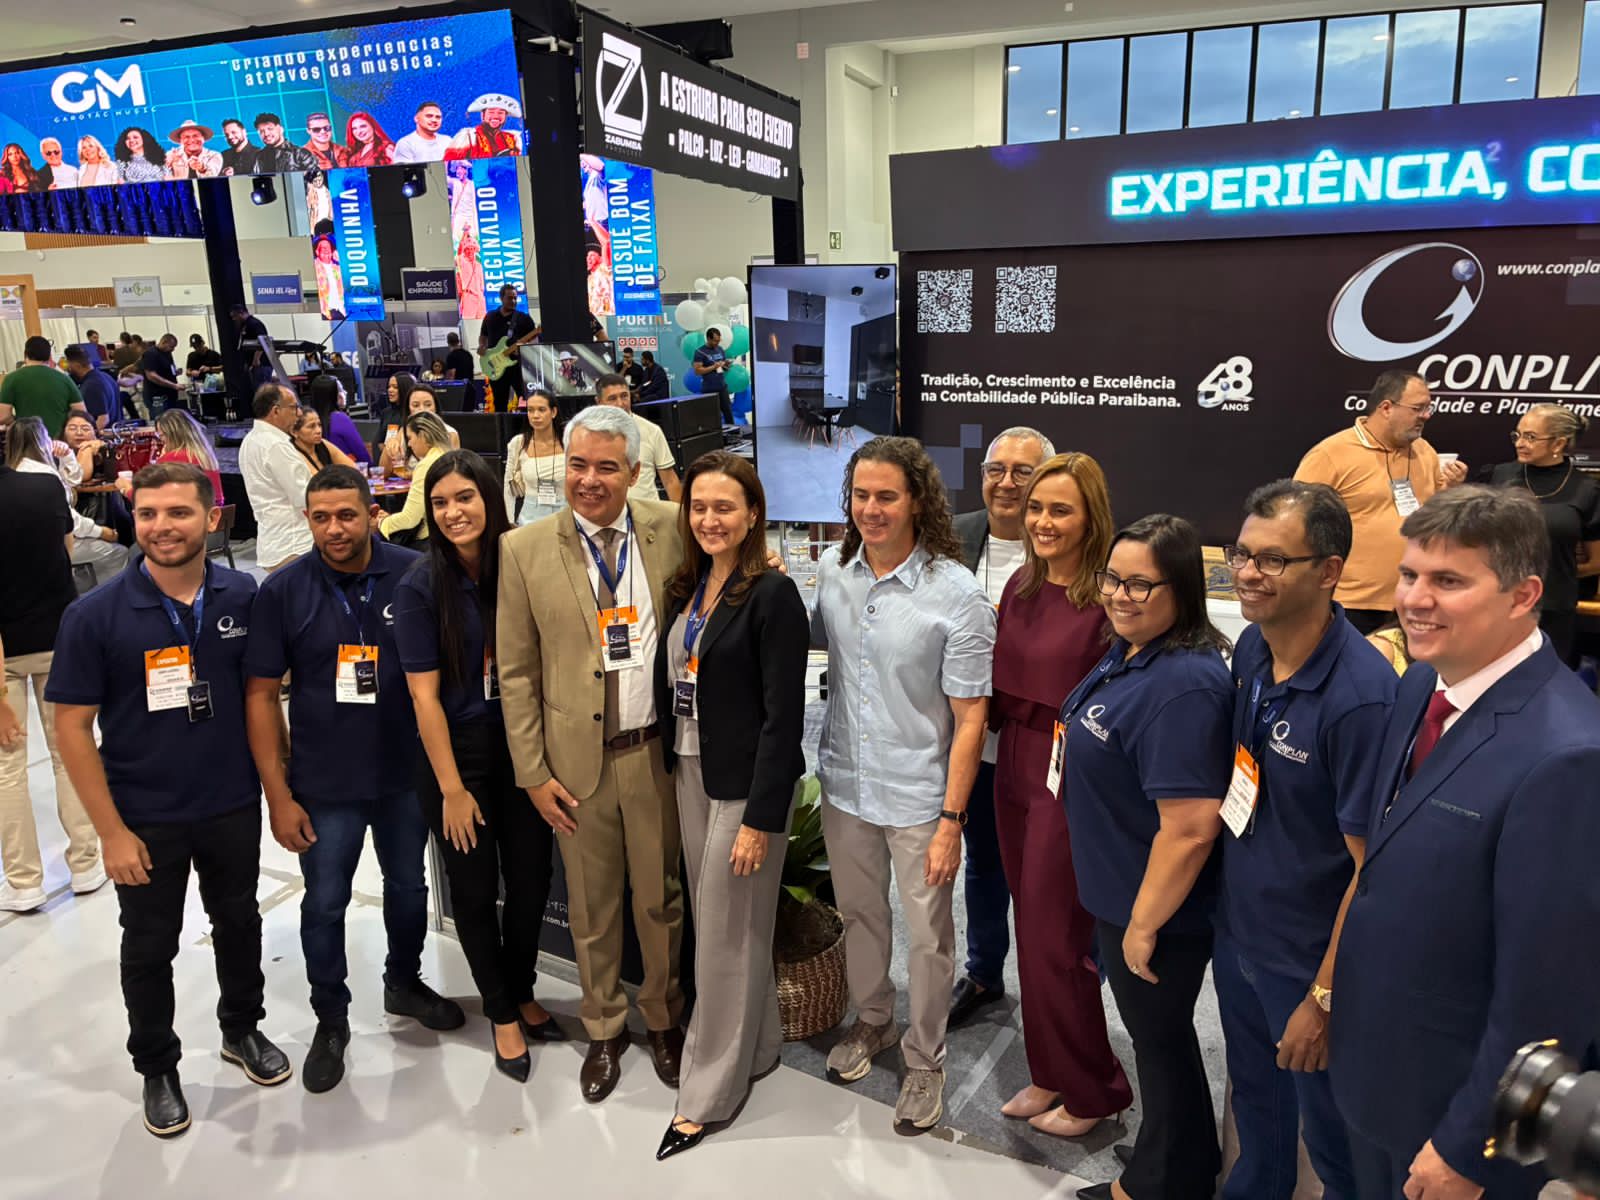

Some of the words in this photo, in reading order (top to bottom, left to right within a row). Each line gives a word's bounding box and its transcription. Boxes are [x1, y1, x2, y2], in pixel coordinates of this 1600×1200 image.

[51, 63, 146, 114] GM
[330, 62, 351, 78] da
[659, 71, 670, 108] A
[671, 75, 719, 125] ESTRURA
[720, 95, 745, 134] PARA
[746, 106, 763, 140] SEU
[764, 113, 793, 150] EVENTO
[678, 128, 704, 159] PALCO
[710, 138, 723, 164] LUZ
[728, 144, 742, 169] LED
[608, 178, 630, 219] BOM
[1110, 149, 1507, 217] EXPERIÊNCIA,
[339, 188, 369, 287] DUQUINHA
[477, 187, 505, 293] REGINALDO
[630, 199, 653, 254] FAIXA
[502, 237, 525, 293] SAMA
[634, 263, 656, 286] DE
[921, 373, 983, 389] Tradição,
[986, 374, 1077, 388] Crescimento
[1080, 378, 1090, 388] e
[1093, 375, 1176, 390] Excelência
[921, 392, 937, 402] na
[940, 390, 1037, 404] Contabilidade
[1040, 390, 1095, 406] Pública
[1099, 392, 1181, 408] Paraibana.
[1198, 355, 1254, 408] 48
[1221, 403, 1249, 411] ANOS
[1479, 401, 1492, 414] e
